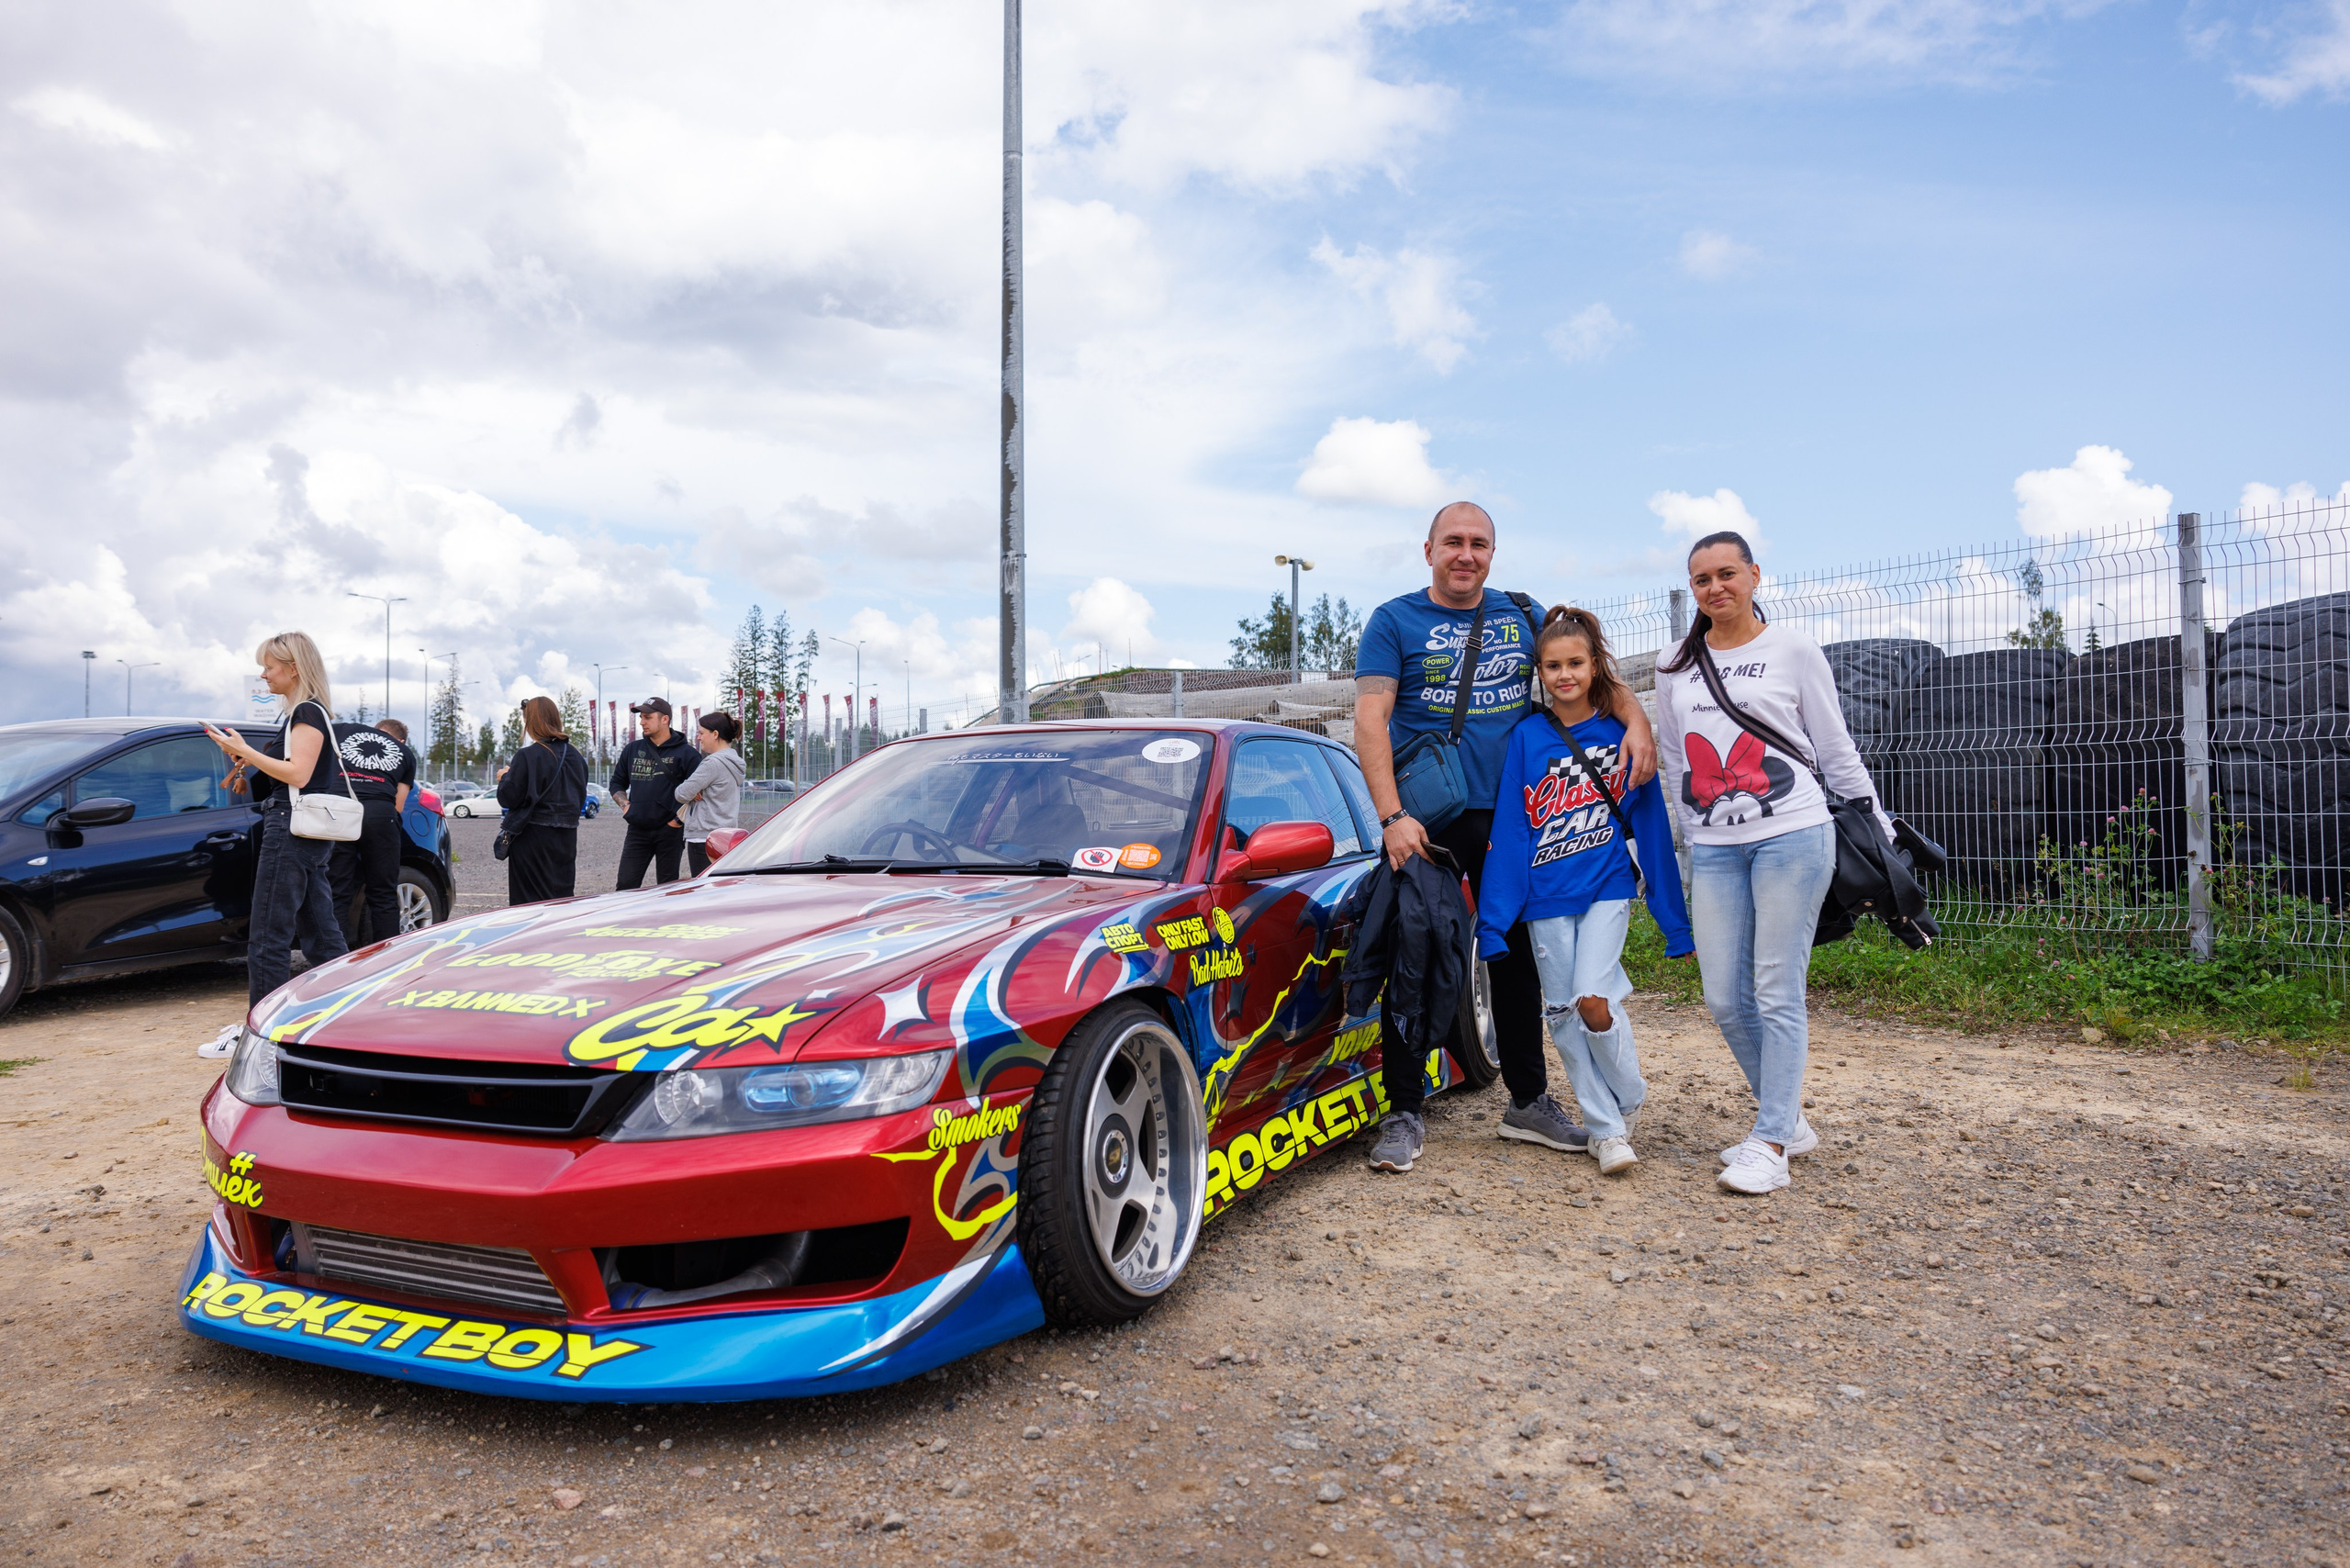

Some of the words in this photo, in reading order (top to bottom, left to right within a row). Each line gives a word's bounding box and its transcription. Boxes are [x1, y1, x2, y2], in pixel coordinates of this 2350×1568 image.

[1501, 624, 1520, 643] 75
[1482, 644, 1521, 654] PERFORMANCE
[1427, 657, 1450, 666] POWER
[1733, 663, 1767, 678] ME!
[1425, 675, 1446, 683] 1998
[1421, 687, 1458, 704] BOR
[1472, 690, 1495, 706] TO
[1498, 681, 1528, 702] RIDE
[1428, 705, 1454, 713] ORIGINA
[1487, 704, 1512, 713] CUSTOM
[1512, 700, 1526, 708] MADE
[1692, 702, 1721, 713] Minnie
[1733, 701, 1749, 710] use
[1538, 804, 1612, 846] CAR
[1532, 827, 1614, 867] RACING
[1102, 923, 1136, 938] АВТО
[1156, 921, 1182, 937] ONLY
[1181, 916, 1205, 935] FAST
[1104, 933, 1144, 949] СПОРТ
[1164, 934, 1190, 951] ONLY
[1188, 929, 1210, 946] LOW
[1190, 950, 1211, 987] Bad
[1210, 946, 1244, 981] Habits
[927, 1096, 1022, 1151] Smokers
[181, 1271, 642, 1378] ROCKETBOY
